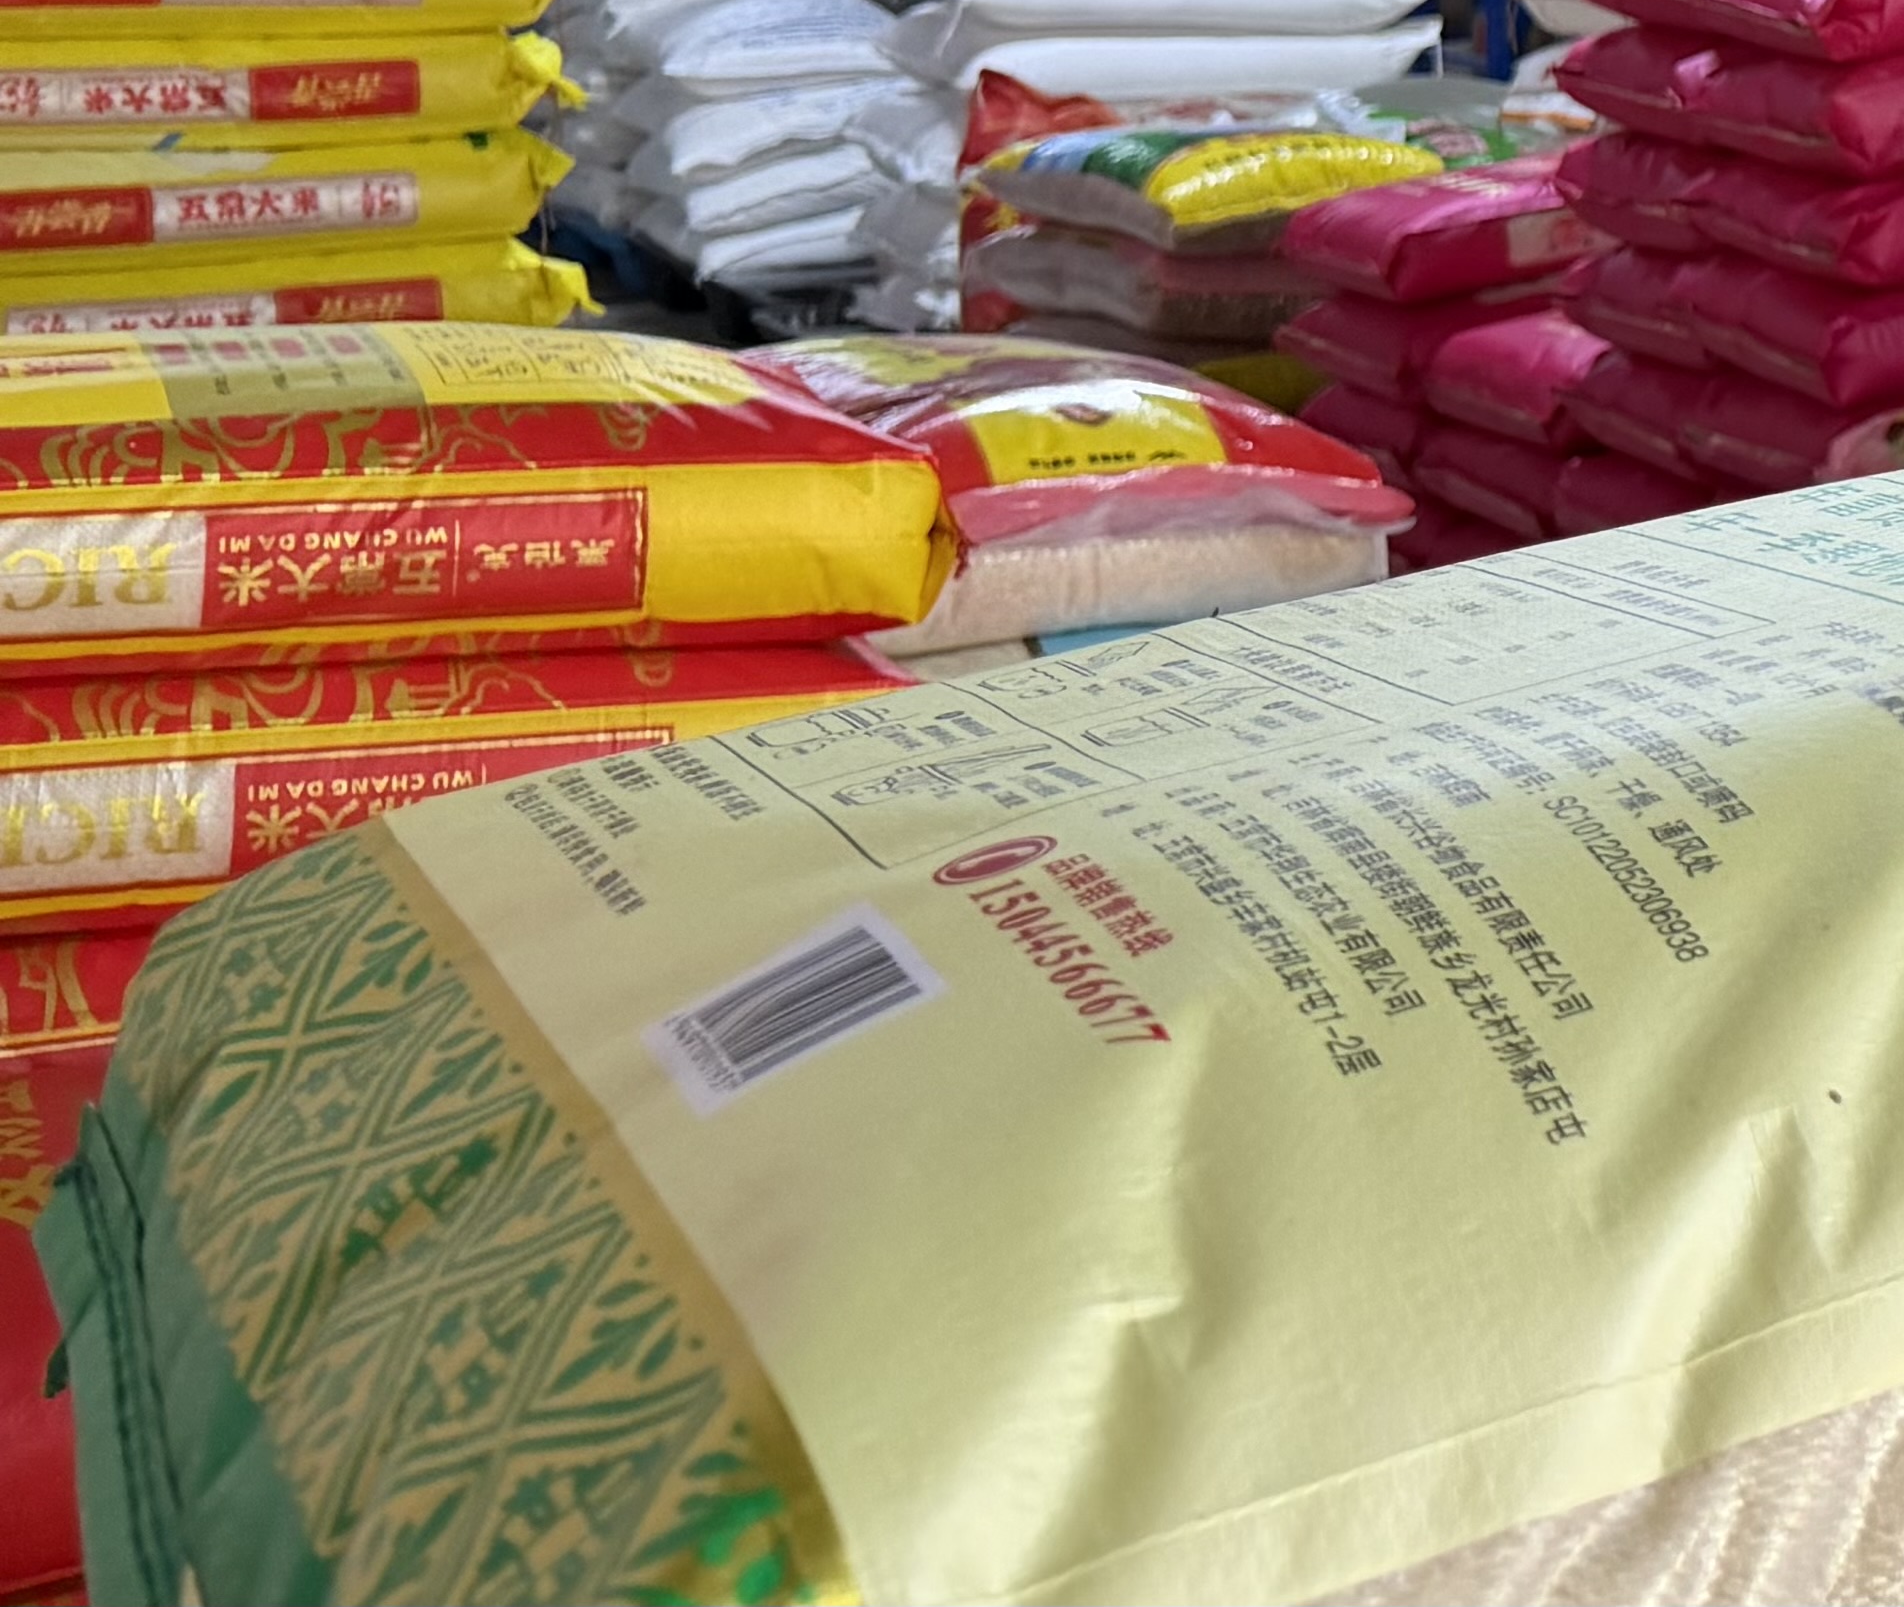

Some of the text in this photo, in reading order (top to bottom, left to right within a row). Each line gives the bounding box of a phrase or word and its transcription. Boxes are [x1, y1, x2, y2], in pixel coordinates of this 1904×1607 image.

[218, 534, 247, 554] MI
[218, 548, 448, 608] 五常大米
[248, 770, 474, 802] WU CHANG DA MI
[1040, 851, 1174, 958] 品牌销售热线
[1540, 793, 1712, 966] SC10122052306938
[967, 878, 1172, 1051] 15044566677
